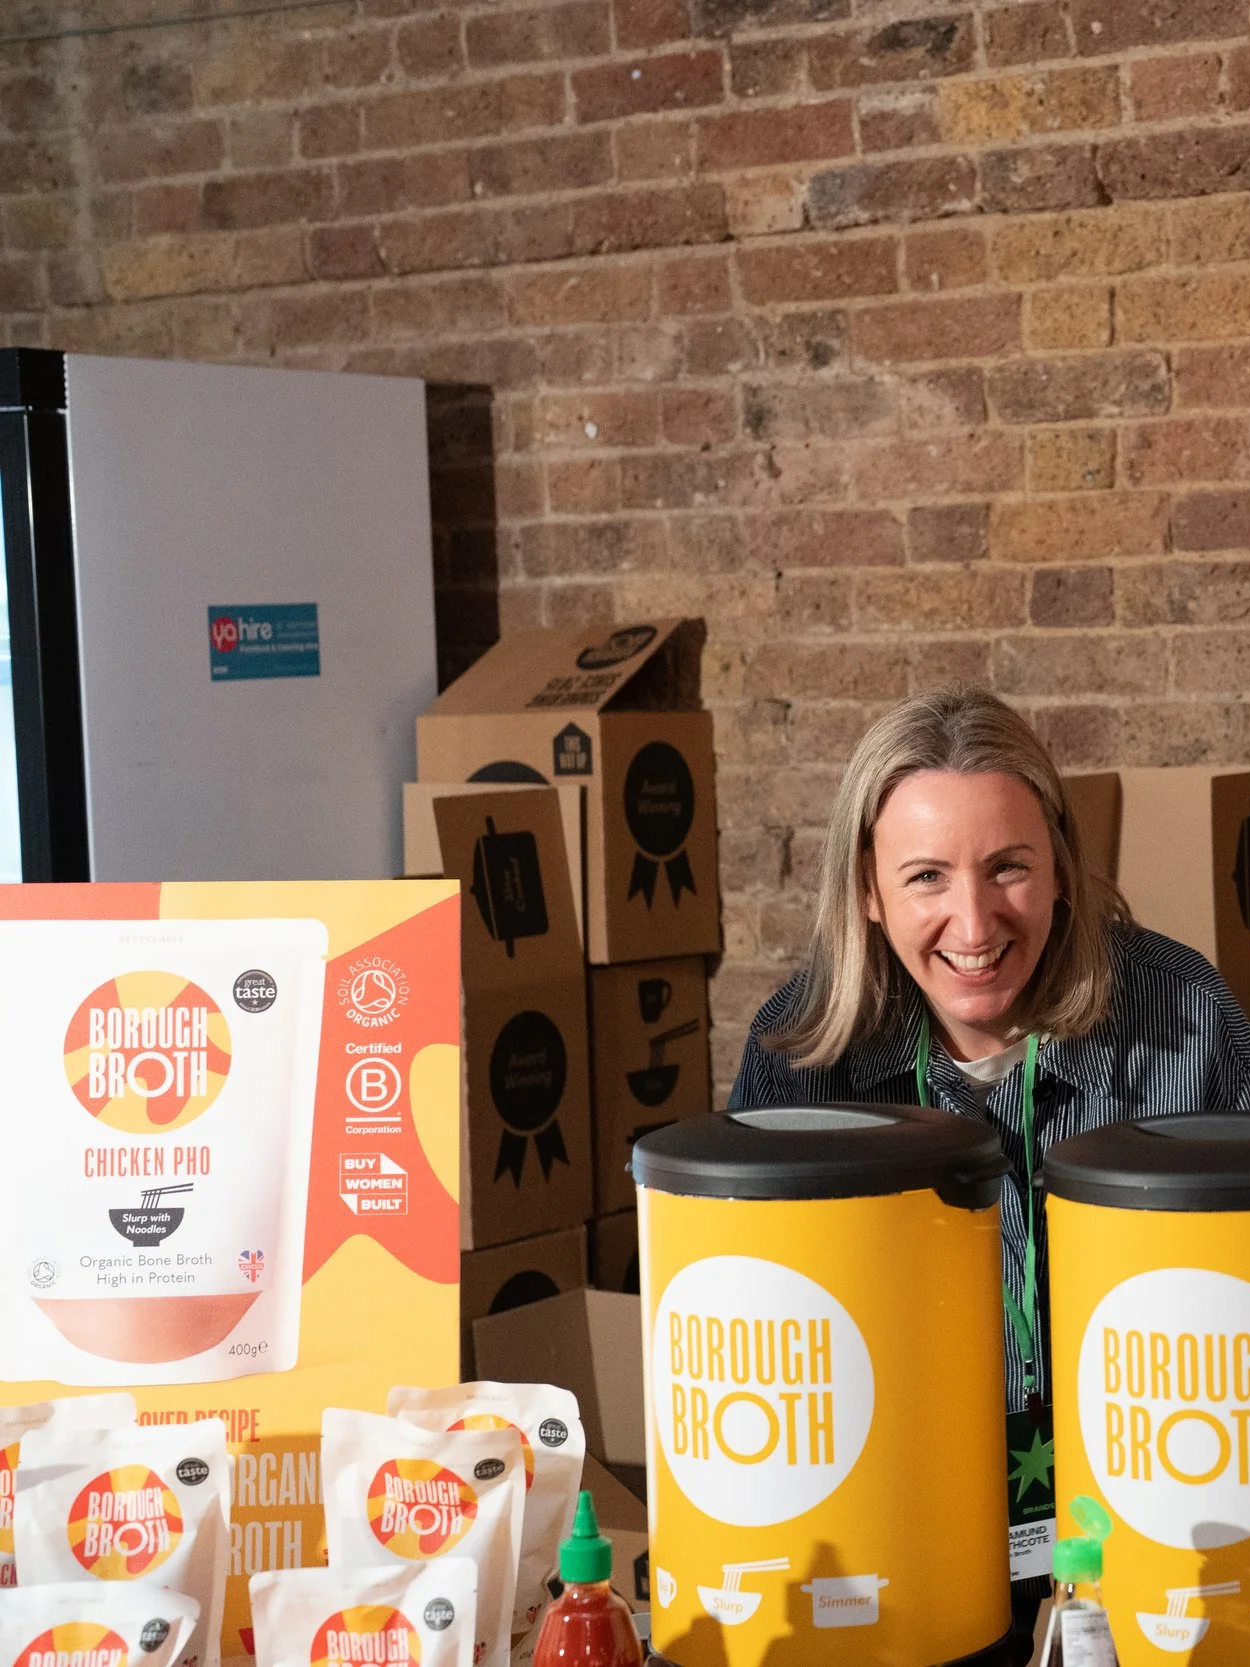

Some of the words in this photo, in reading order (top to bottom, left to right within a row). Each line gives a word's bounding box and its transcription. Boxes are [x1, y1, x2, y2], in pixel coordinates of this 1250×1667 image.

[244, 978, 266, 987] great
[338, 978, 351, 1006] SOIL
[348, 956, 410, 1006] ASSOCIATION
[235, 986, 276, 998] taste
[346, 1008, 401, 1027] ORGANIC
[89, 1006, 208, 1049] BOROUGH
[345, 1042, 402, 1054] Certified
[89, 1050, 208, 1099] BROTH
[361, 1068, 388, 1102] B
[345, 1125, 402, 1136] Corporation
[84, 1146, 165, 1178] CHICKEN
[173, 1145, 212, 1176] PHO
[344, 1158, 377, 1170] BUY
[345, 1178, 403, 1190] WOMEN
[361, 1198, 403, 1210] BUILT
[122, 1213, 148, 1224] Slurp
[149, 1212, 171, 1223] with
[126, 1224, 167, 1235] Noodles
[79, 1254, 133, 1270] Organic
[138, 1254, 172, 1267] Bone
[176, 1253, 212, 1266] Broth
[97, 1272, 127, 1288] High
[132, 1272, 144, 1284] in
[149, 1272, 196, 1284] Protein
[669, 1311, 832, 1386] BOROUGH
[540, 1427, 567, 1439] taste
[671, 1382, 835, 1466] BROTH
[178, 1465, 209, 1478] taste
[385, 1472, 461, 1505] BOROUGH
[88, 1486, 165, 1522] BOROUGH
[381, 1500, 463, 1536] BROTH
[84, 1521, 170, 1558] BROTH
[227, 1521, 303, 1577] ROTH
[712, 1597, 744, 1614] Slurp
[818, 1594, 873, 1609] Simmer
[1155, 1622, 1190, 1641] Slurp
[327, 1627, 409, 1663] BOROUGH
